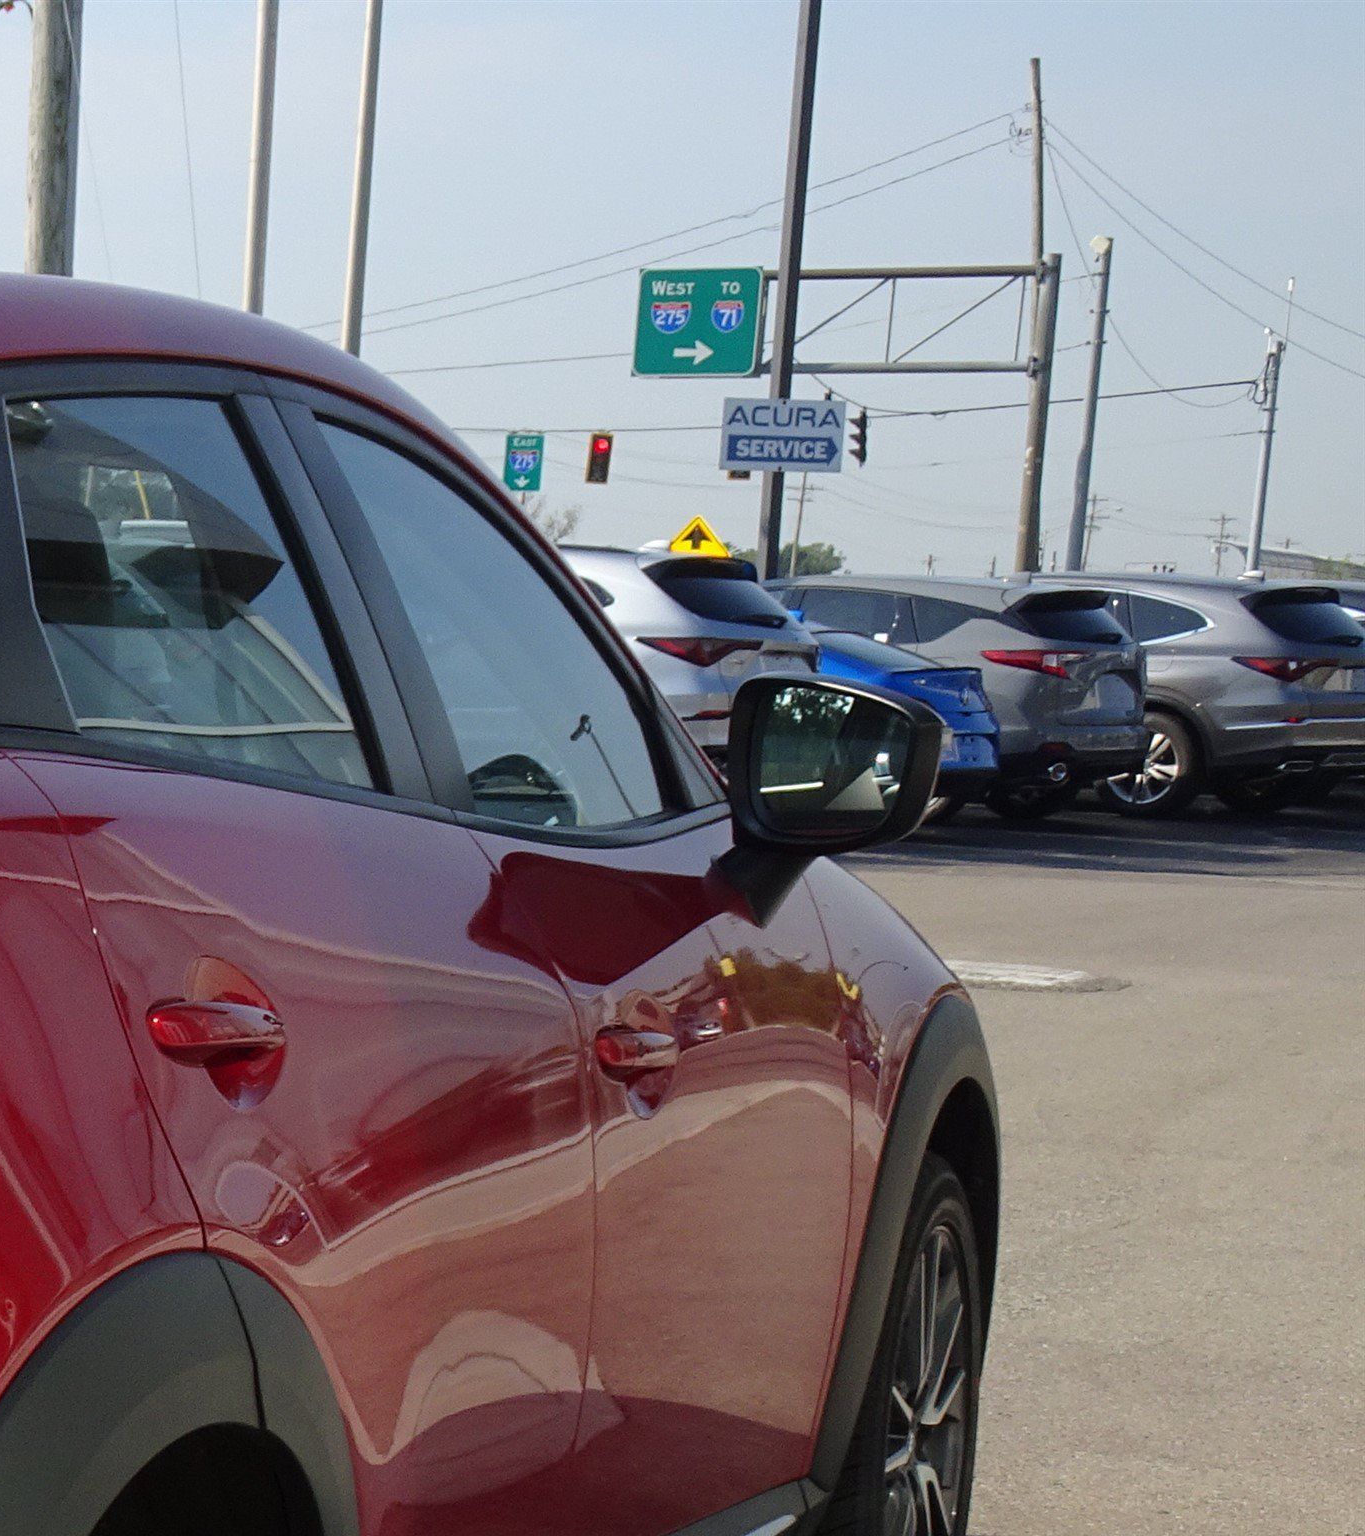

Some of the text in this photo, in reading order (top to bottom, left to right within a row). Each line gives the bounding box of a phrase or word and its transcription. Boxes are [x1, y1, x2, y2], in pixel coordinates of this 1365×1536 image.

[652, 280, 742, 296] WEST TO
[655, 309, 737, 327] 275 71
[727, 405, 841, 428] ACURA
[736, 439, 829, 459] SERVICE
[515, 454, 533, 469] 275
